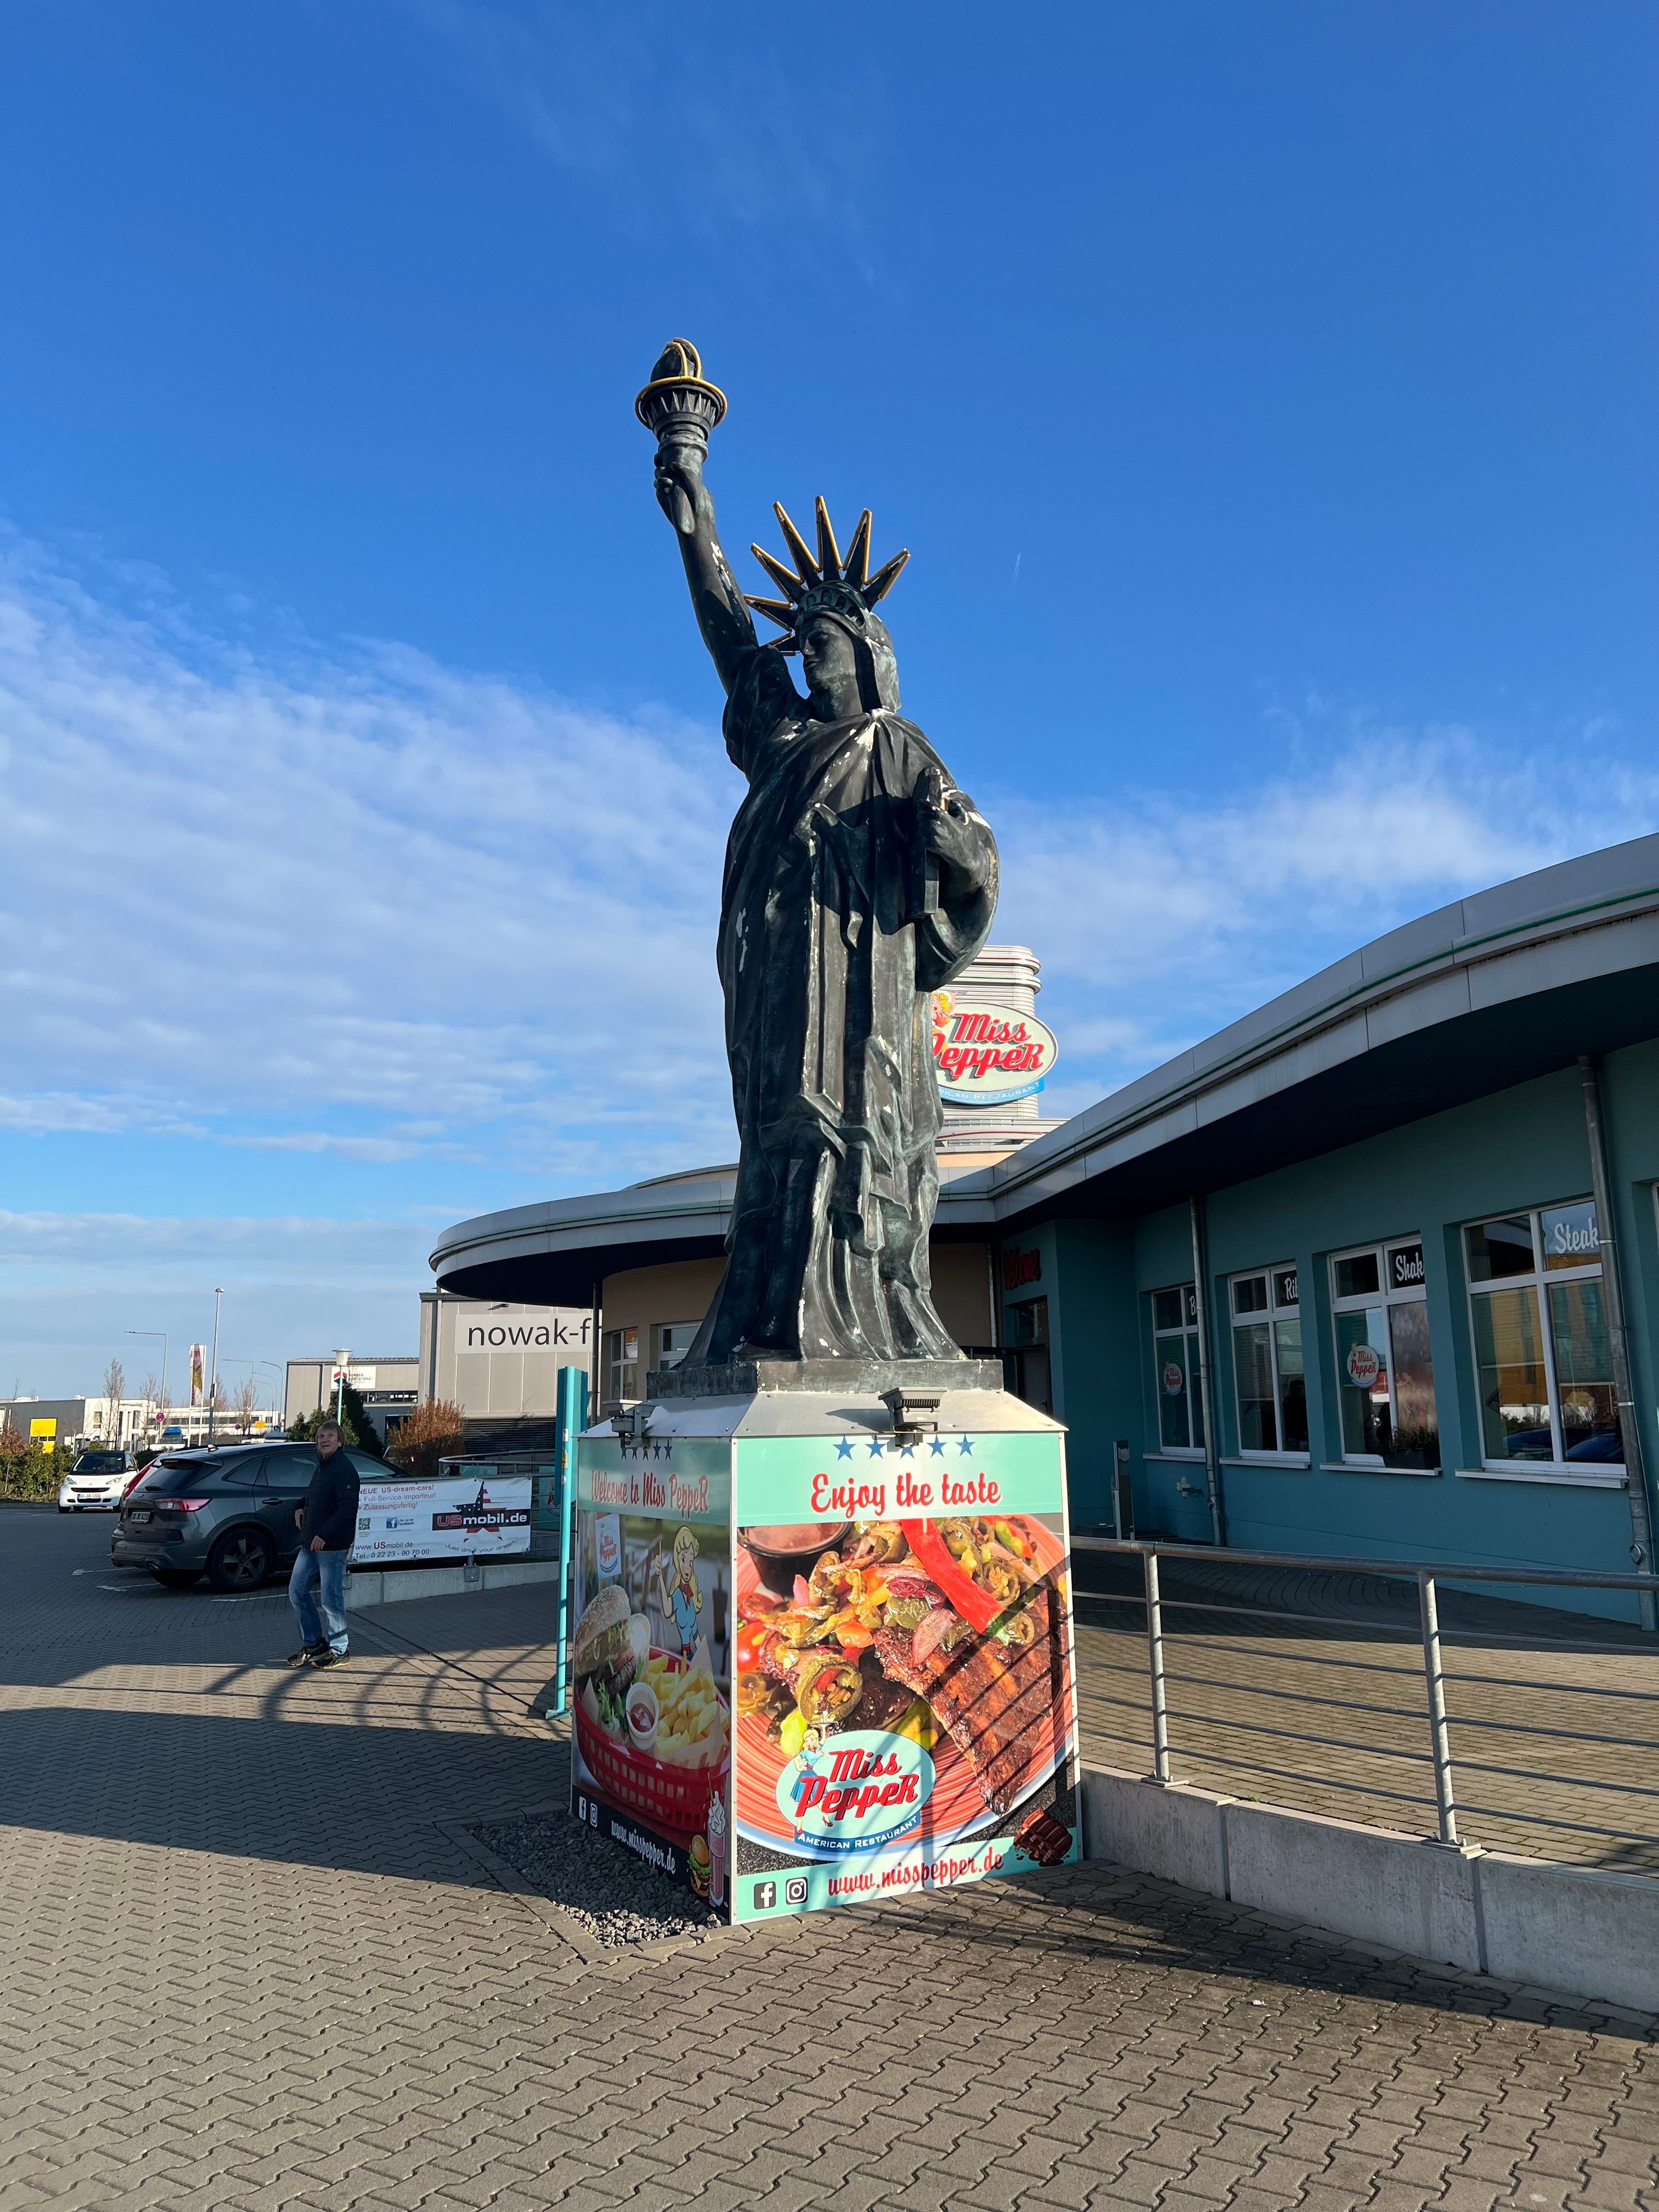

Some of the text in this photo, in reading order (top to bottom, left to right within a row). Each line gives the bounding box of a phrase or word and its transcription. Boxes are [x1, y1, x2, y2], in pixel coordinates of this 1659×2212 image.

[953, 1013, 1031, 1042] Miss
[939, 1082, 1040, 1101] RICAN RESTAURANT
[1395, 1252, 1425, 1281] Shak
[1189, 1295, 1197, 1316] B
[468, 1317, 602, 1346] nowak-f
[364, 1492, 436, 1502] Full-Service-Importeur!
[381, 1484, 435, 1493] US-dream-cars!
[591, 1470, 628, 1504] Welcome
[630, 1475, 640, 1504] to
[642, 1472, 666, 1508] Miss
[810, 1471, 1002, 1519] Enjoy the taste
[364, 1502, 418, 1510] Zulassungsfertig!
[437, 1513, 527, 1527] USmobil.de
[828, 1748, 903, 1782] Miss
[797, 1815, 917, 1849] AMERICAN RESTAURANT
[612, 1820, 675, 1875] www.misspepper.de
[827, 1846, 1005, 1896] www.misspepper.de
